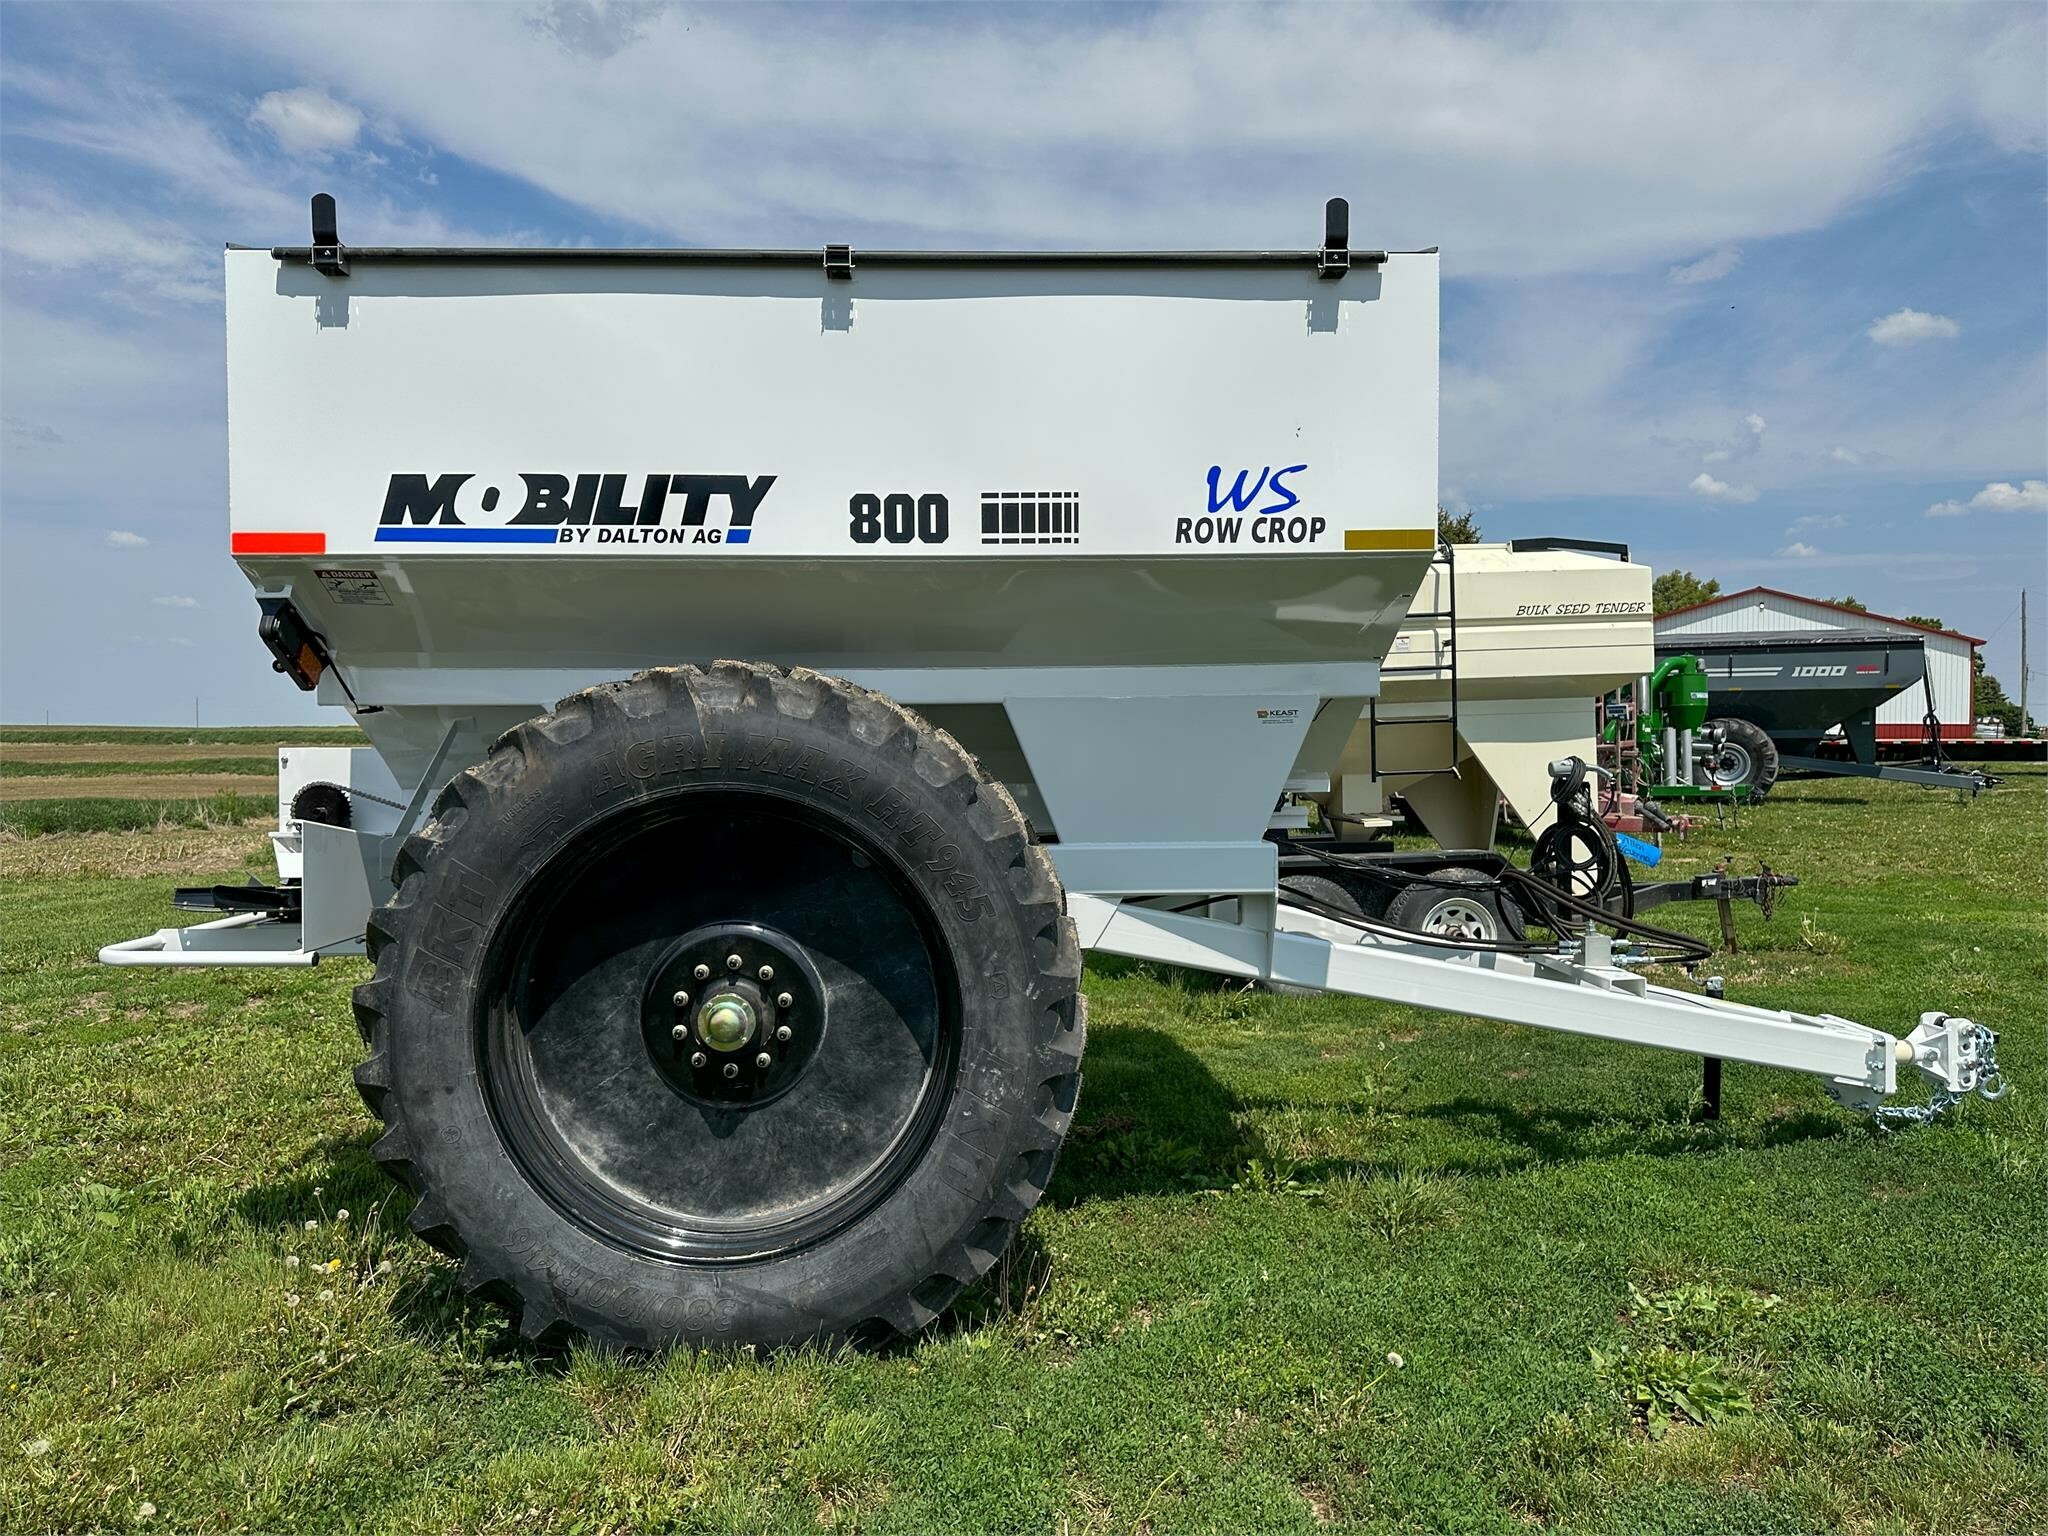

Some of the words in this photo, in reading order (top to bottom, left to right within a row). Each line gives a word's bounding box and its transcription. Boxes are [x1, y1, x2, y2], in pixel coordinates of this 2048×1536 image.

[378, 473, 778, 526] MOBILITY
[1206, 464, 1308, 515] WS
[849, 493, 949, 544] 800
[1175, 517, 1247, 544] ROW
[1251, 516, 1326, 543] CROP
[559, 528, 591, 544] BY
[597, 528, 684, 544] DALTON
[692, 529, 723, 545] AG
[1516, 604, 1551, 616] BULK
[1555, 603, 1590, 615] SEED
[1791, 665, 1848, 677] 1000
